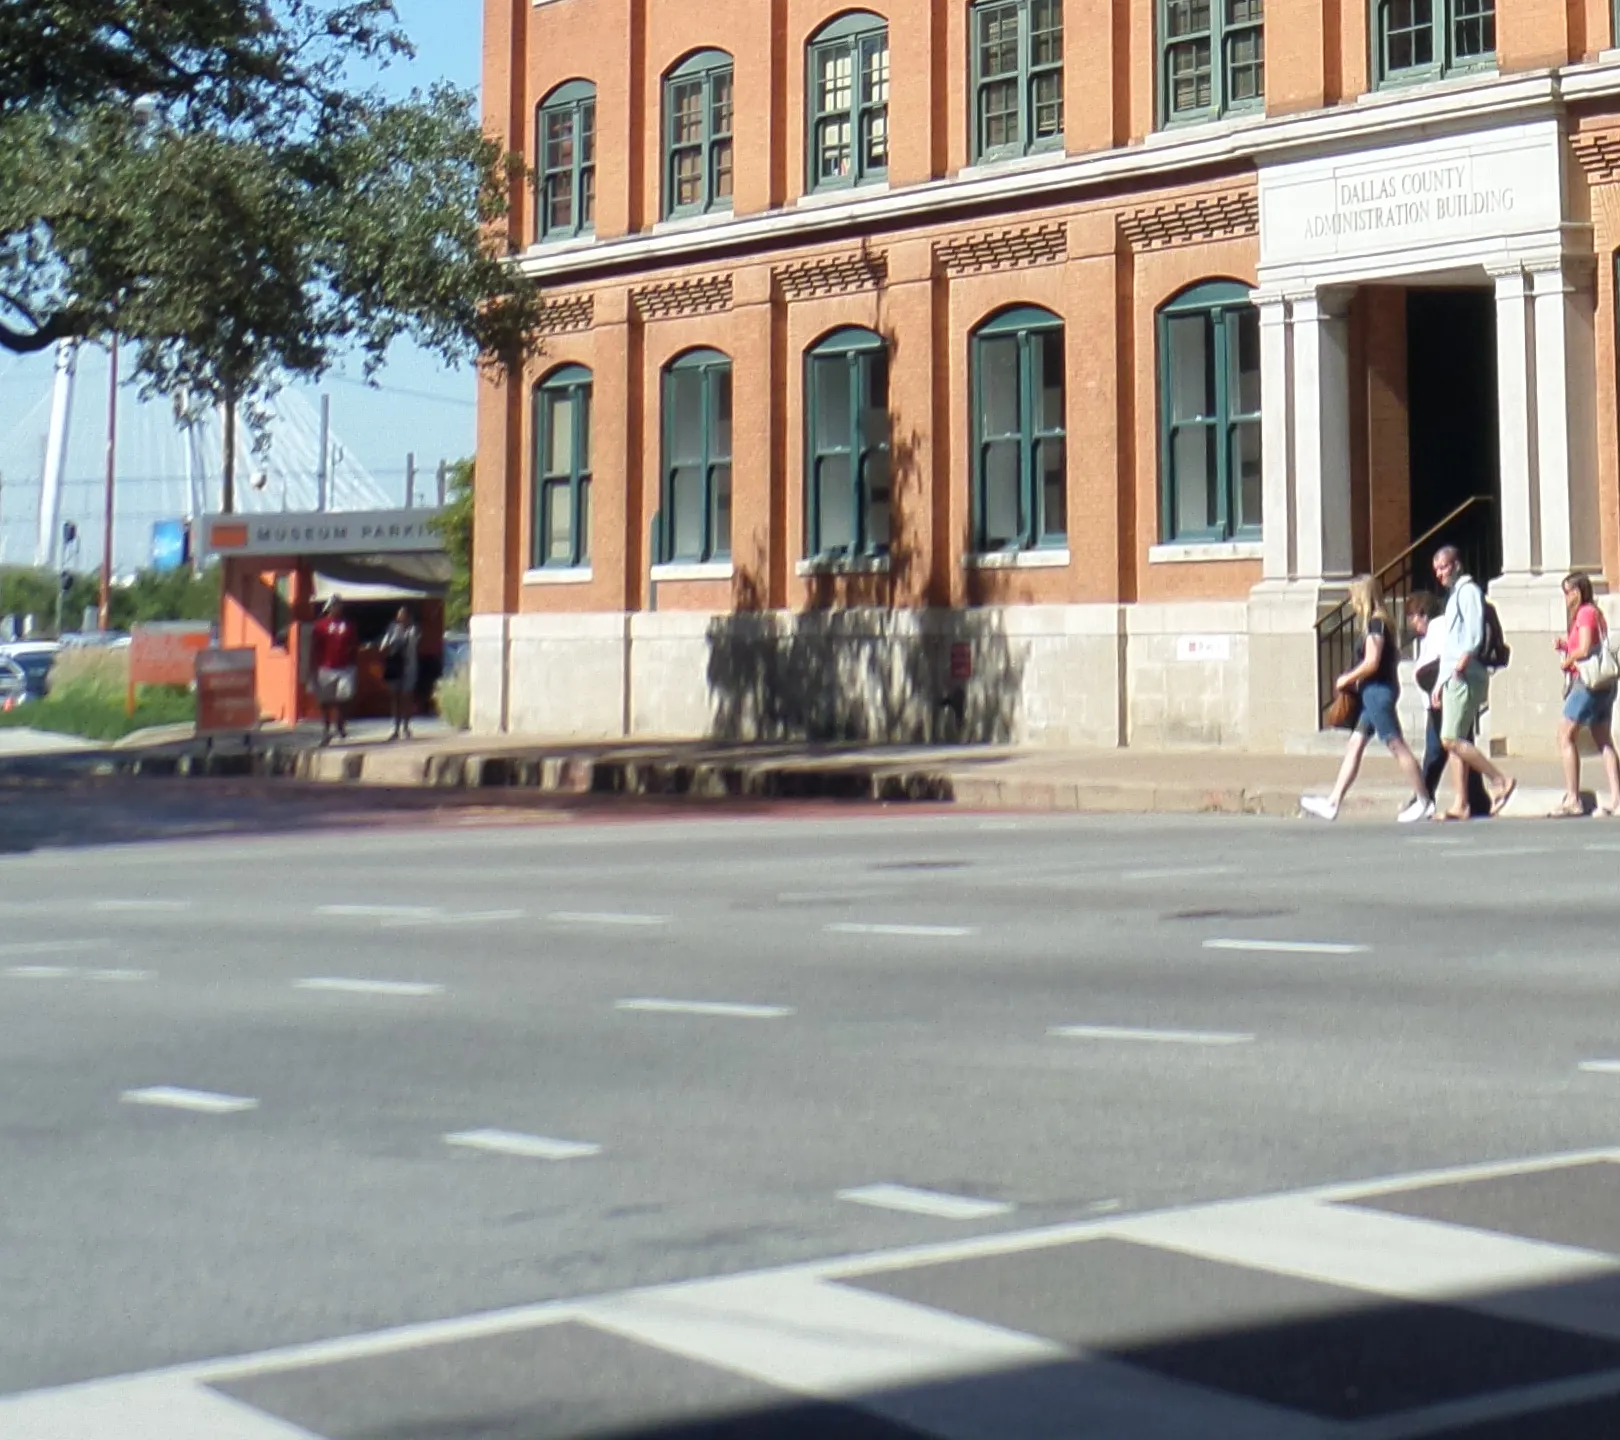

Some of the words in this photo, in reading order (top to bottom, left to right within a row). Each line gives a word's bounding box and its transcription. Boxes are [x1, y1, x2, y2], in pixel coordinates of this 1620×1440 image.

[1340, 176, 1396, 206] DALLAS
[1401, 164, 1466, 195] COUNTY
[1304, 199, 1430, 239] ADMINISTRATION
[1436, 187, 1514, 220] BUILDING
[256, 524, 348, 542] MUSEUM
